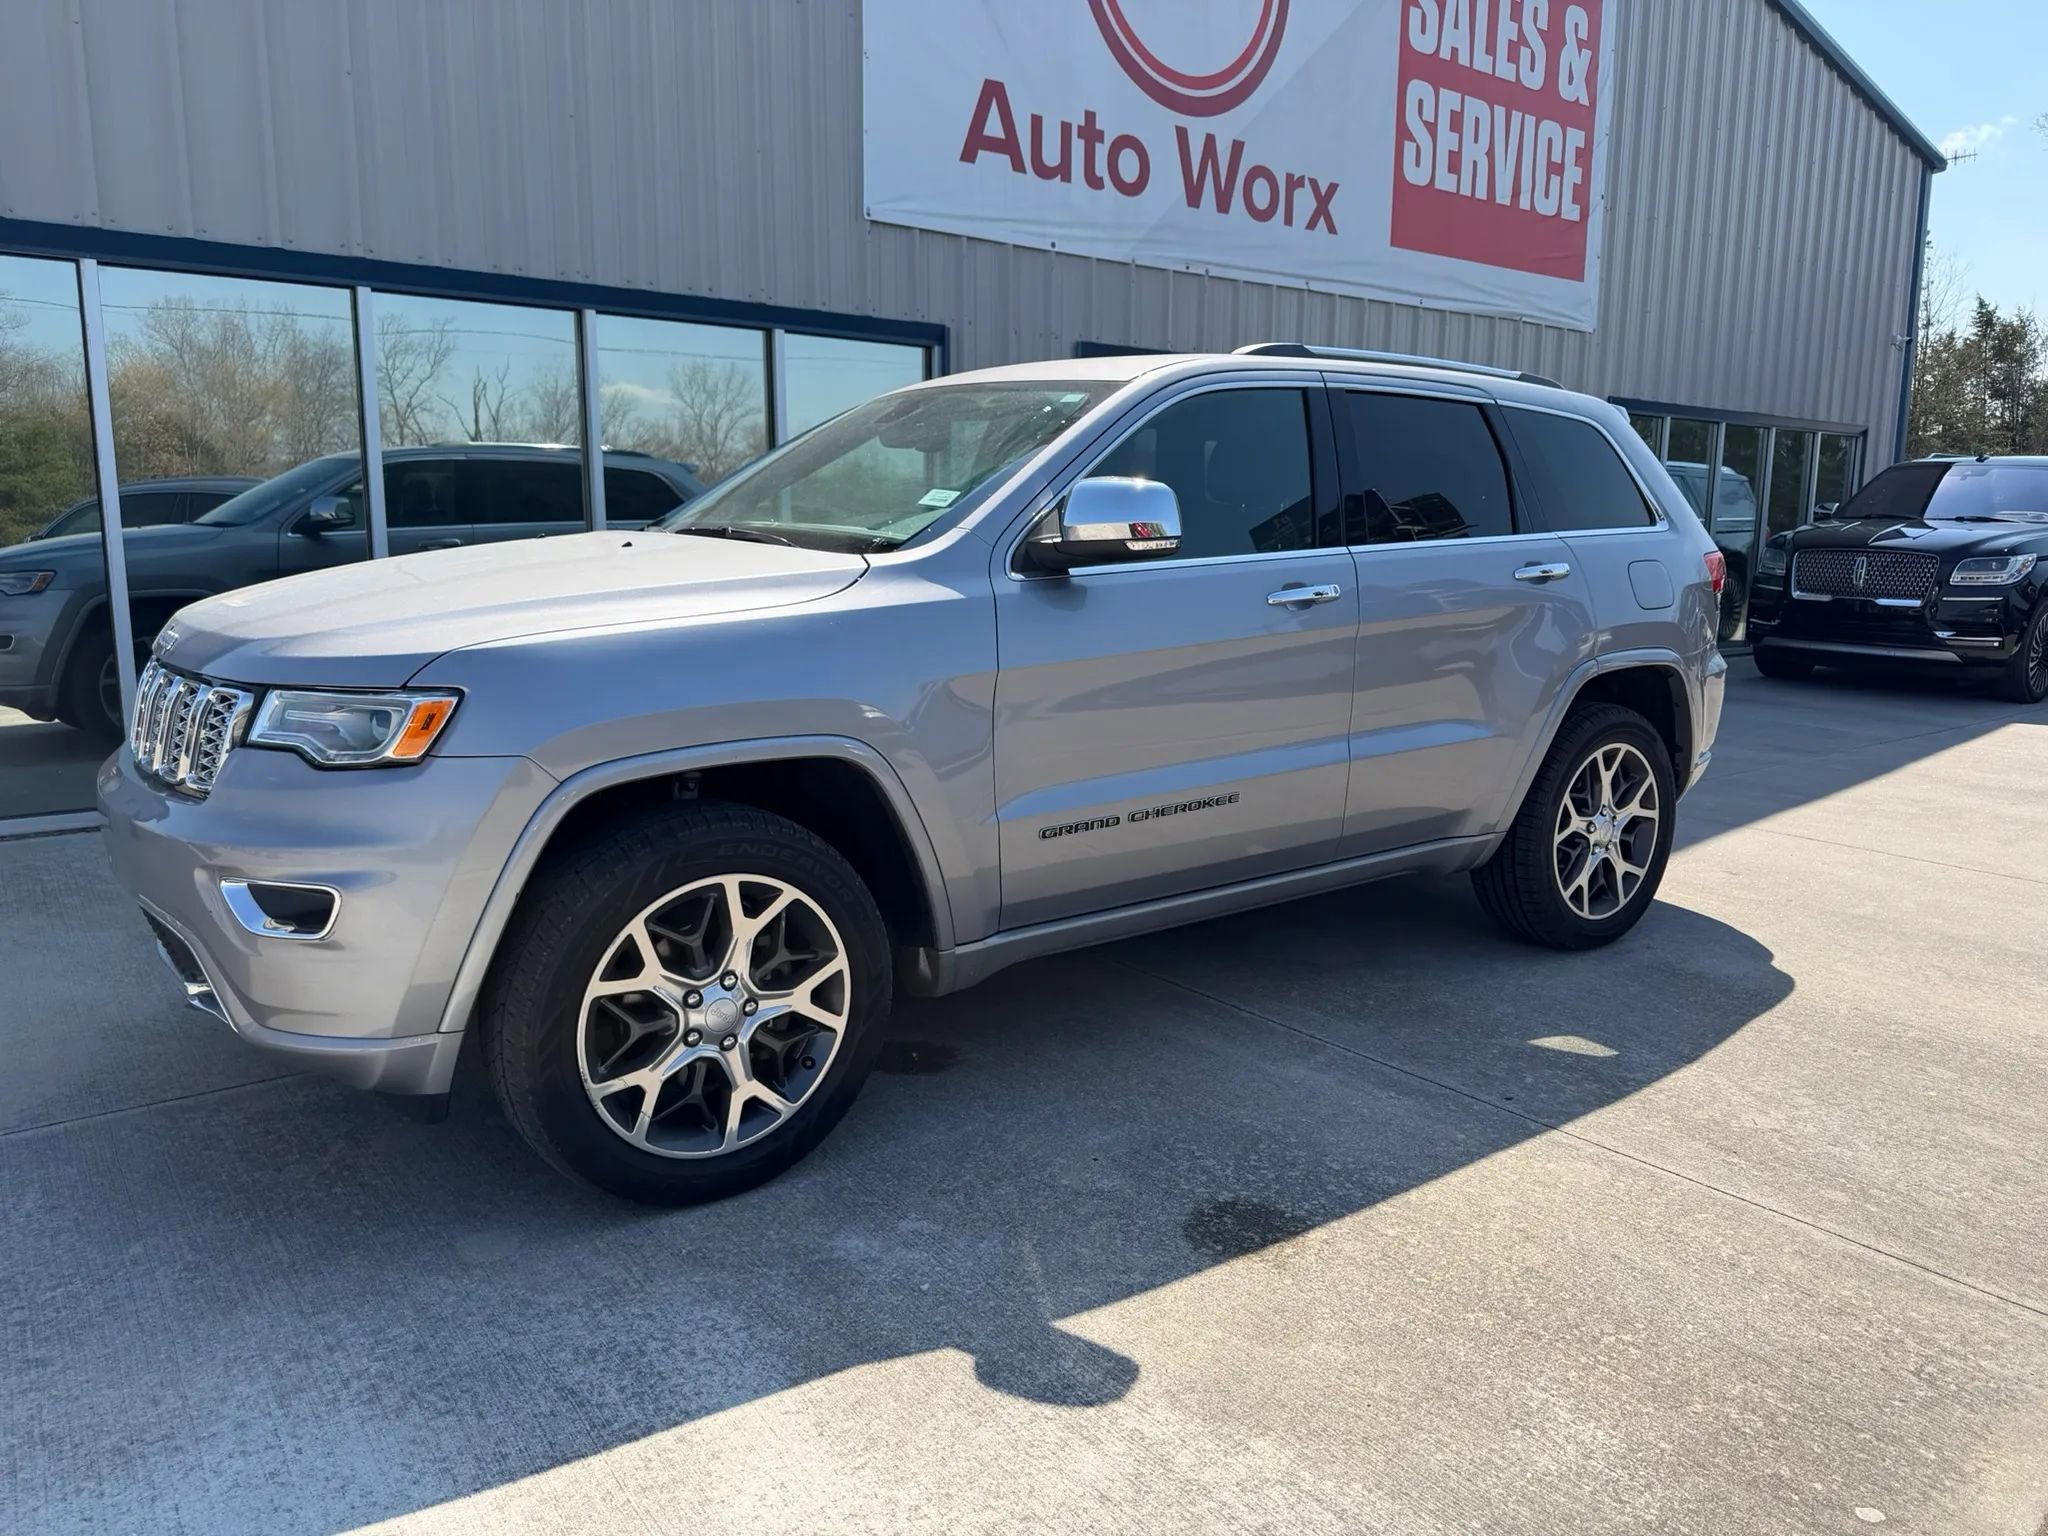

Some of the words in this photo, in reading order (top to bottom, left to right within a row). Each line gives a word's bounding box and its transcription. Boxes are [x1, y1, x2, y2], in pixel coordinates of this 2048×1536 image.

[1408, 0, 1549, 91] SALES
[1558, 4, 1592, 107] &
[960, 78, 1151, 198] Auto
[1174, 125, 1339, 236] Worx
[1403, 79, 1585, 222] SERVICE
[1039, 815, 1121, 841] GRAND
[1128, 791, 1240, 823] CHEROKEE
